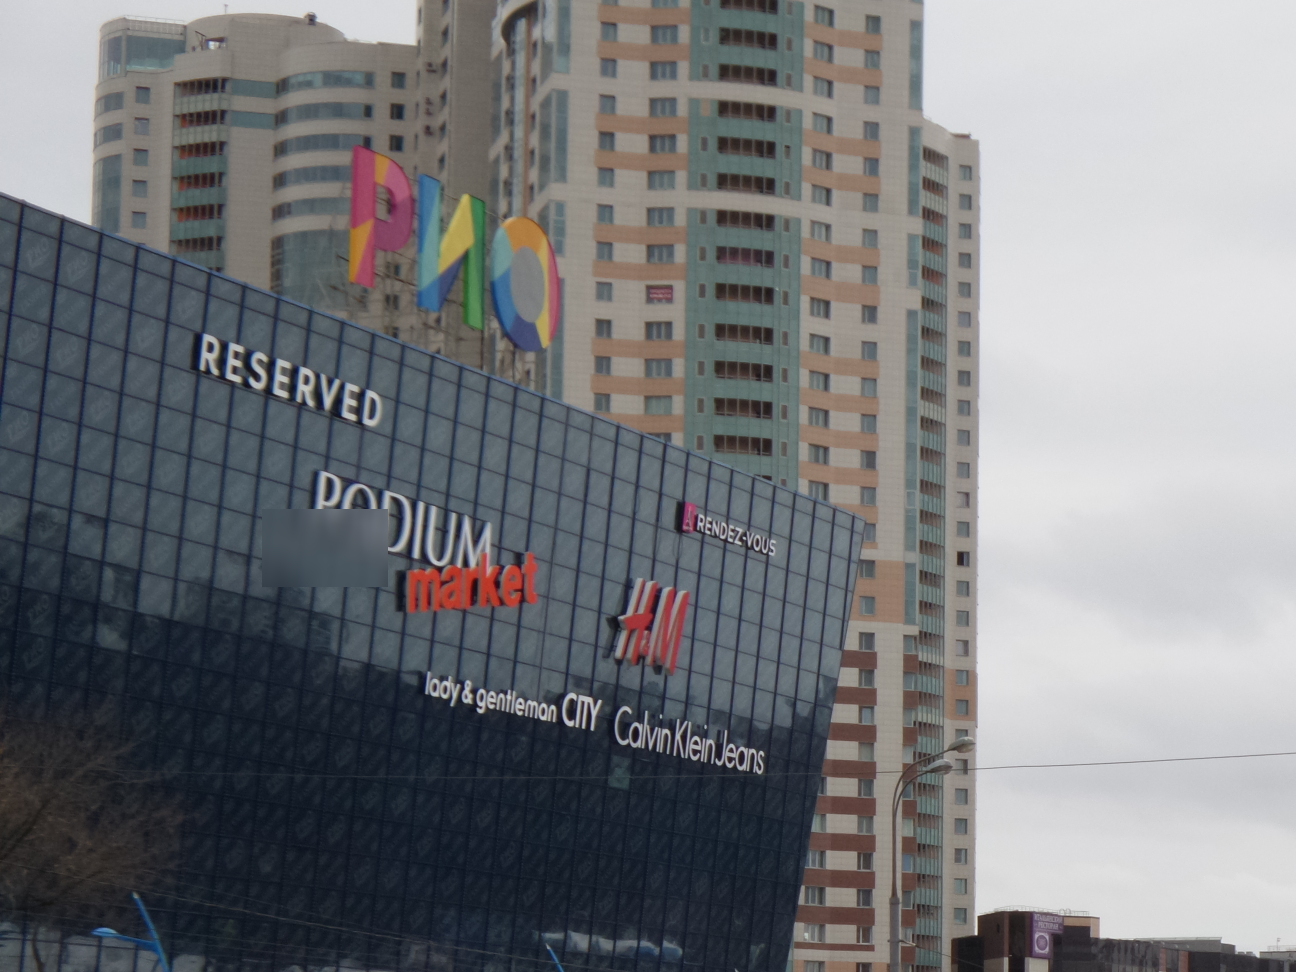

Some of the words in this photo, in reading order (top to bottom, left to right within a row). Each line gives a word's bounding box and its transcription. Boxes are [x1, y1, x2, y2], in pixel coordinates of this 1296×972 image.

[349, 145, 562, 352] РИО
[199, 333, 383, 428] RESERVED
[696, 514, 777, 556] RENDEZ-VOUS
[405, 551, 539, 614] market
[615, 578, 691, 676] H&M
[425, 671, 461, 707] lady
[461, 680, 474, 705] &
[476, 687, 557, 723] gentleman
[561, 692, 603, 731] CITY
[614, 706, 672, 755] Calvin
[673, 719, 716, 765] Klein
[715, 730, 765, 775] Jeans
